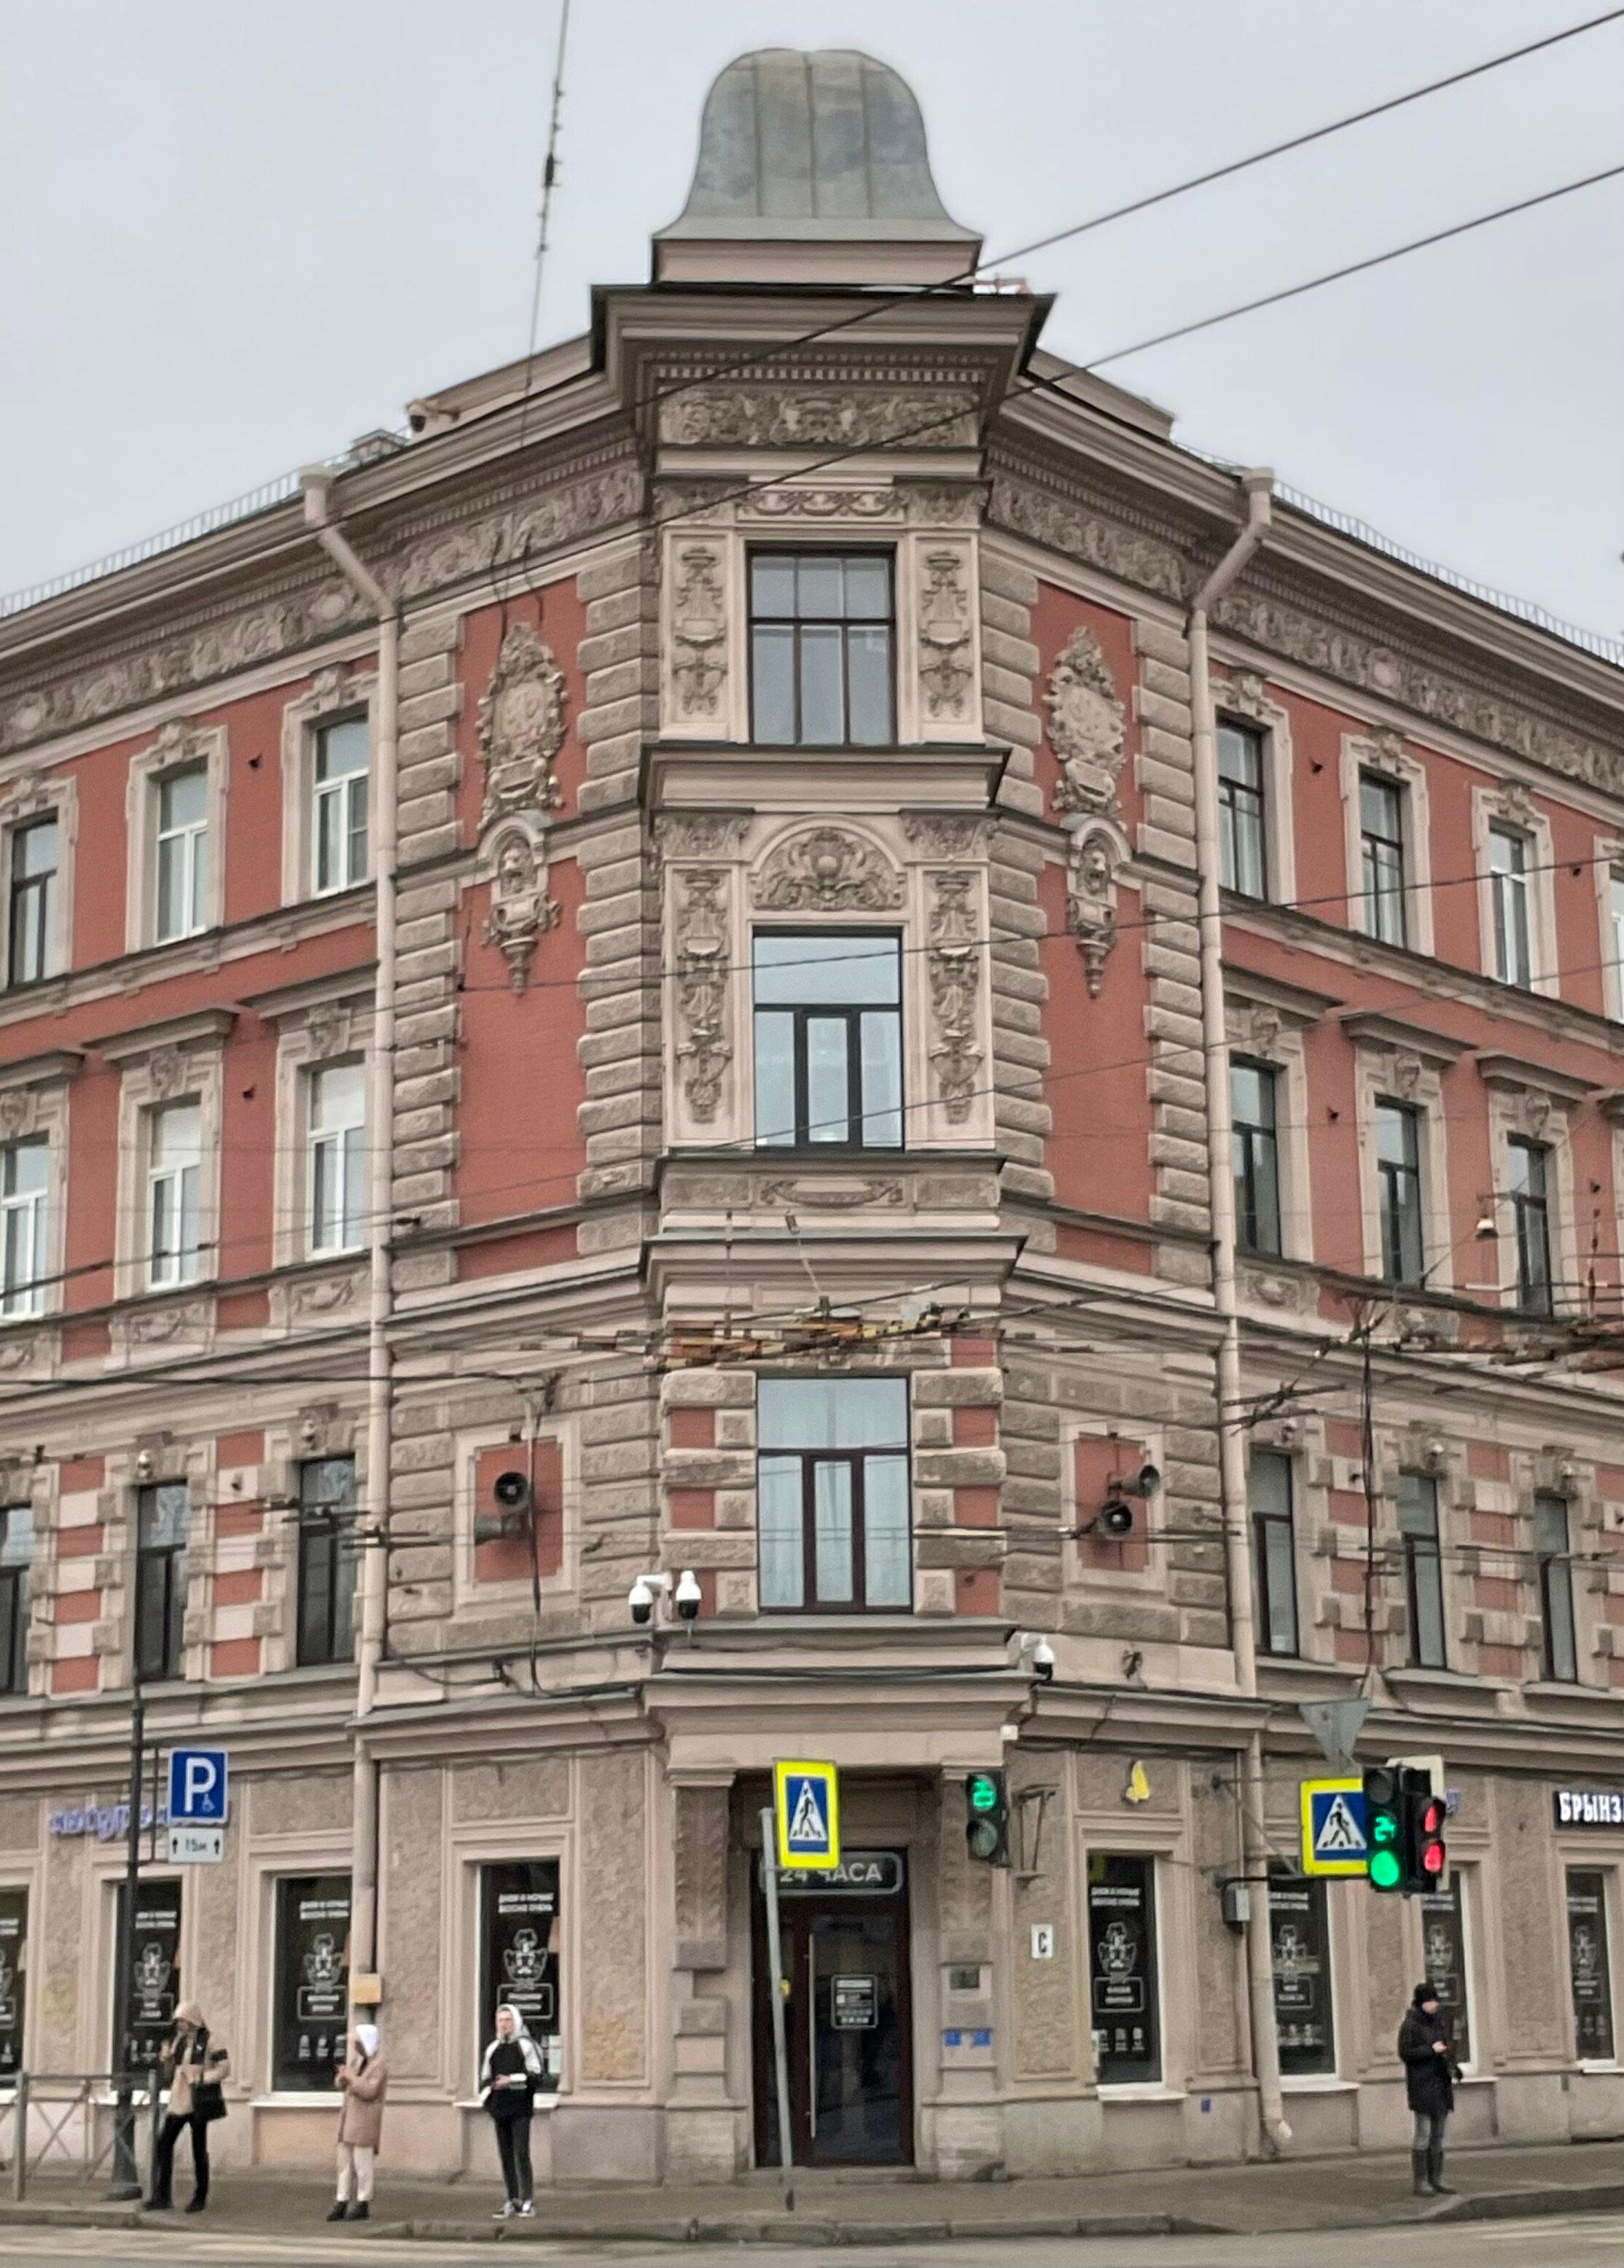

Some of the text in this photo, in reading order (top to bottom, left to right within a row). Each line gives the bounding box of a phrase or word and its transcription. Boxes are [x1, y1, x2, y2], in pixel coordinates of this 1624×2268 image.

[184, 1757, 216, 1812] P
[1559, 1792, 1624, 1822] БРЫНЗ
[817, 1863, 883, 1882] ЧАСА
